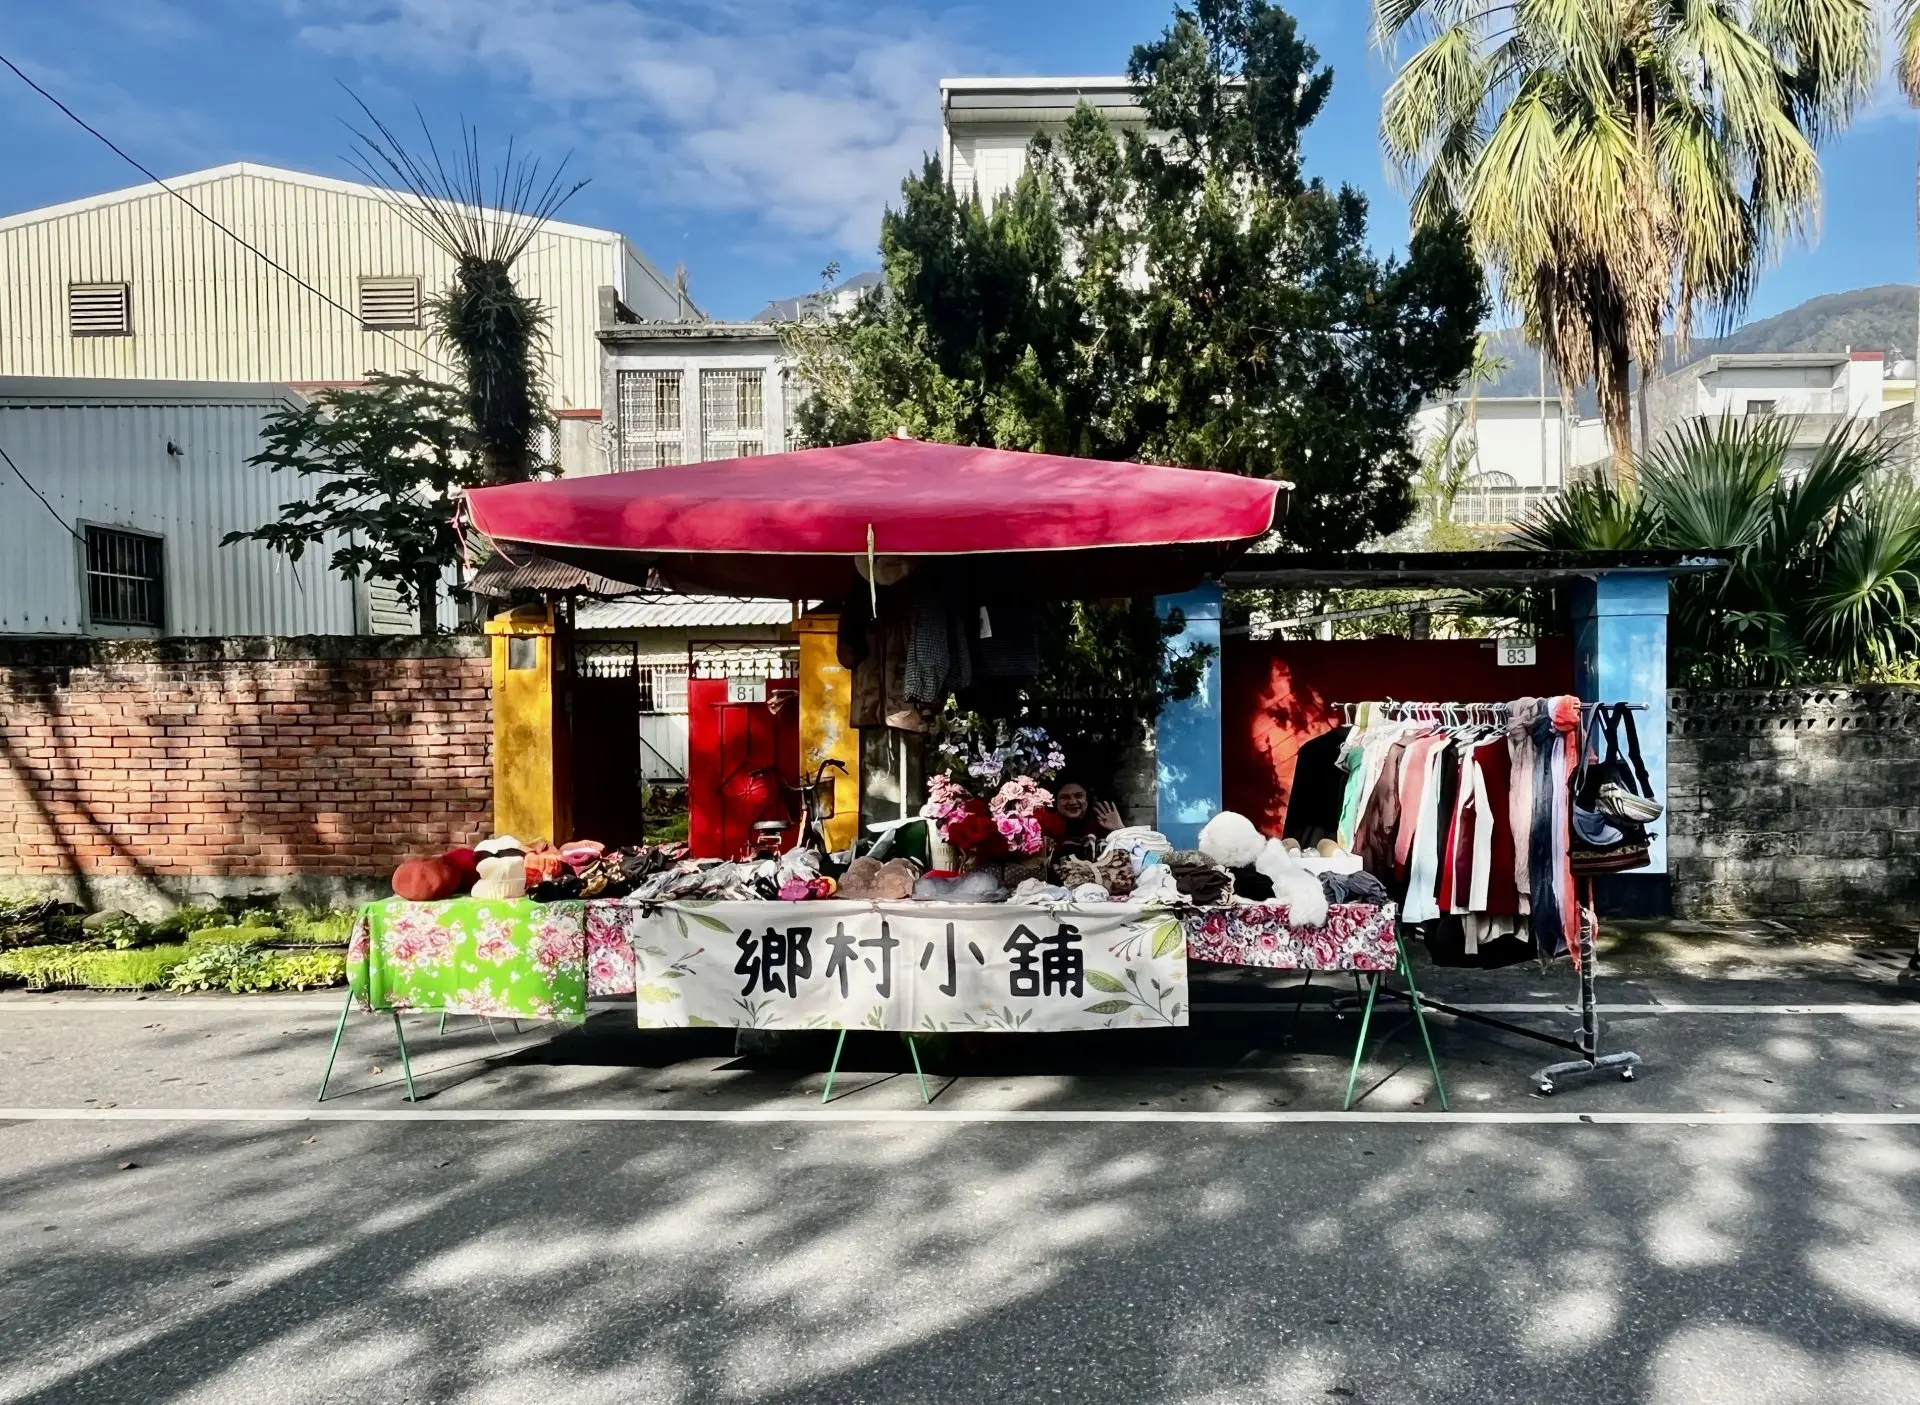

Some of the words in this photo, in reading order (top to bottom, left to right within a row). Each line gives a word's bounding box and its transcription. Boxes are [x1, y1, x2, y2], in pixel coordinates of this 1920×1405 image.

[1507, 649, 1526, 664] 83
[737, 686, 755, 701] 81
[733, 921, 1085, 999] 鄉村小舖
